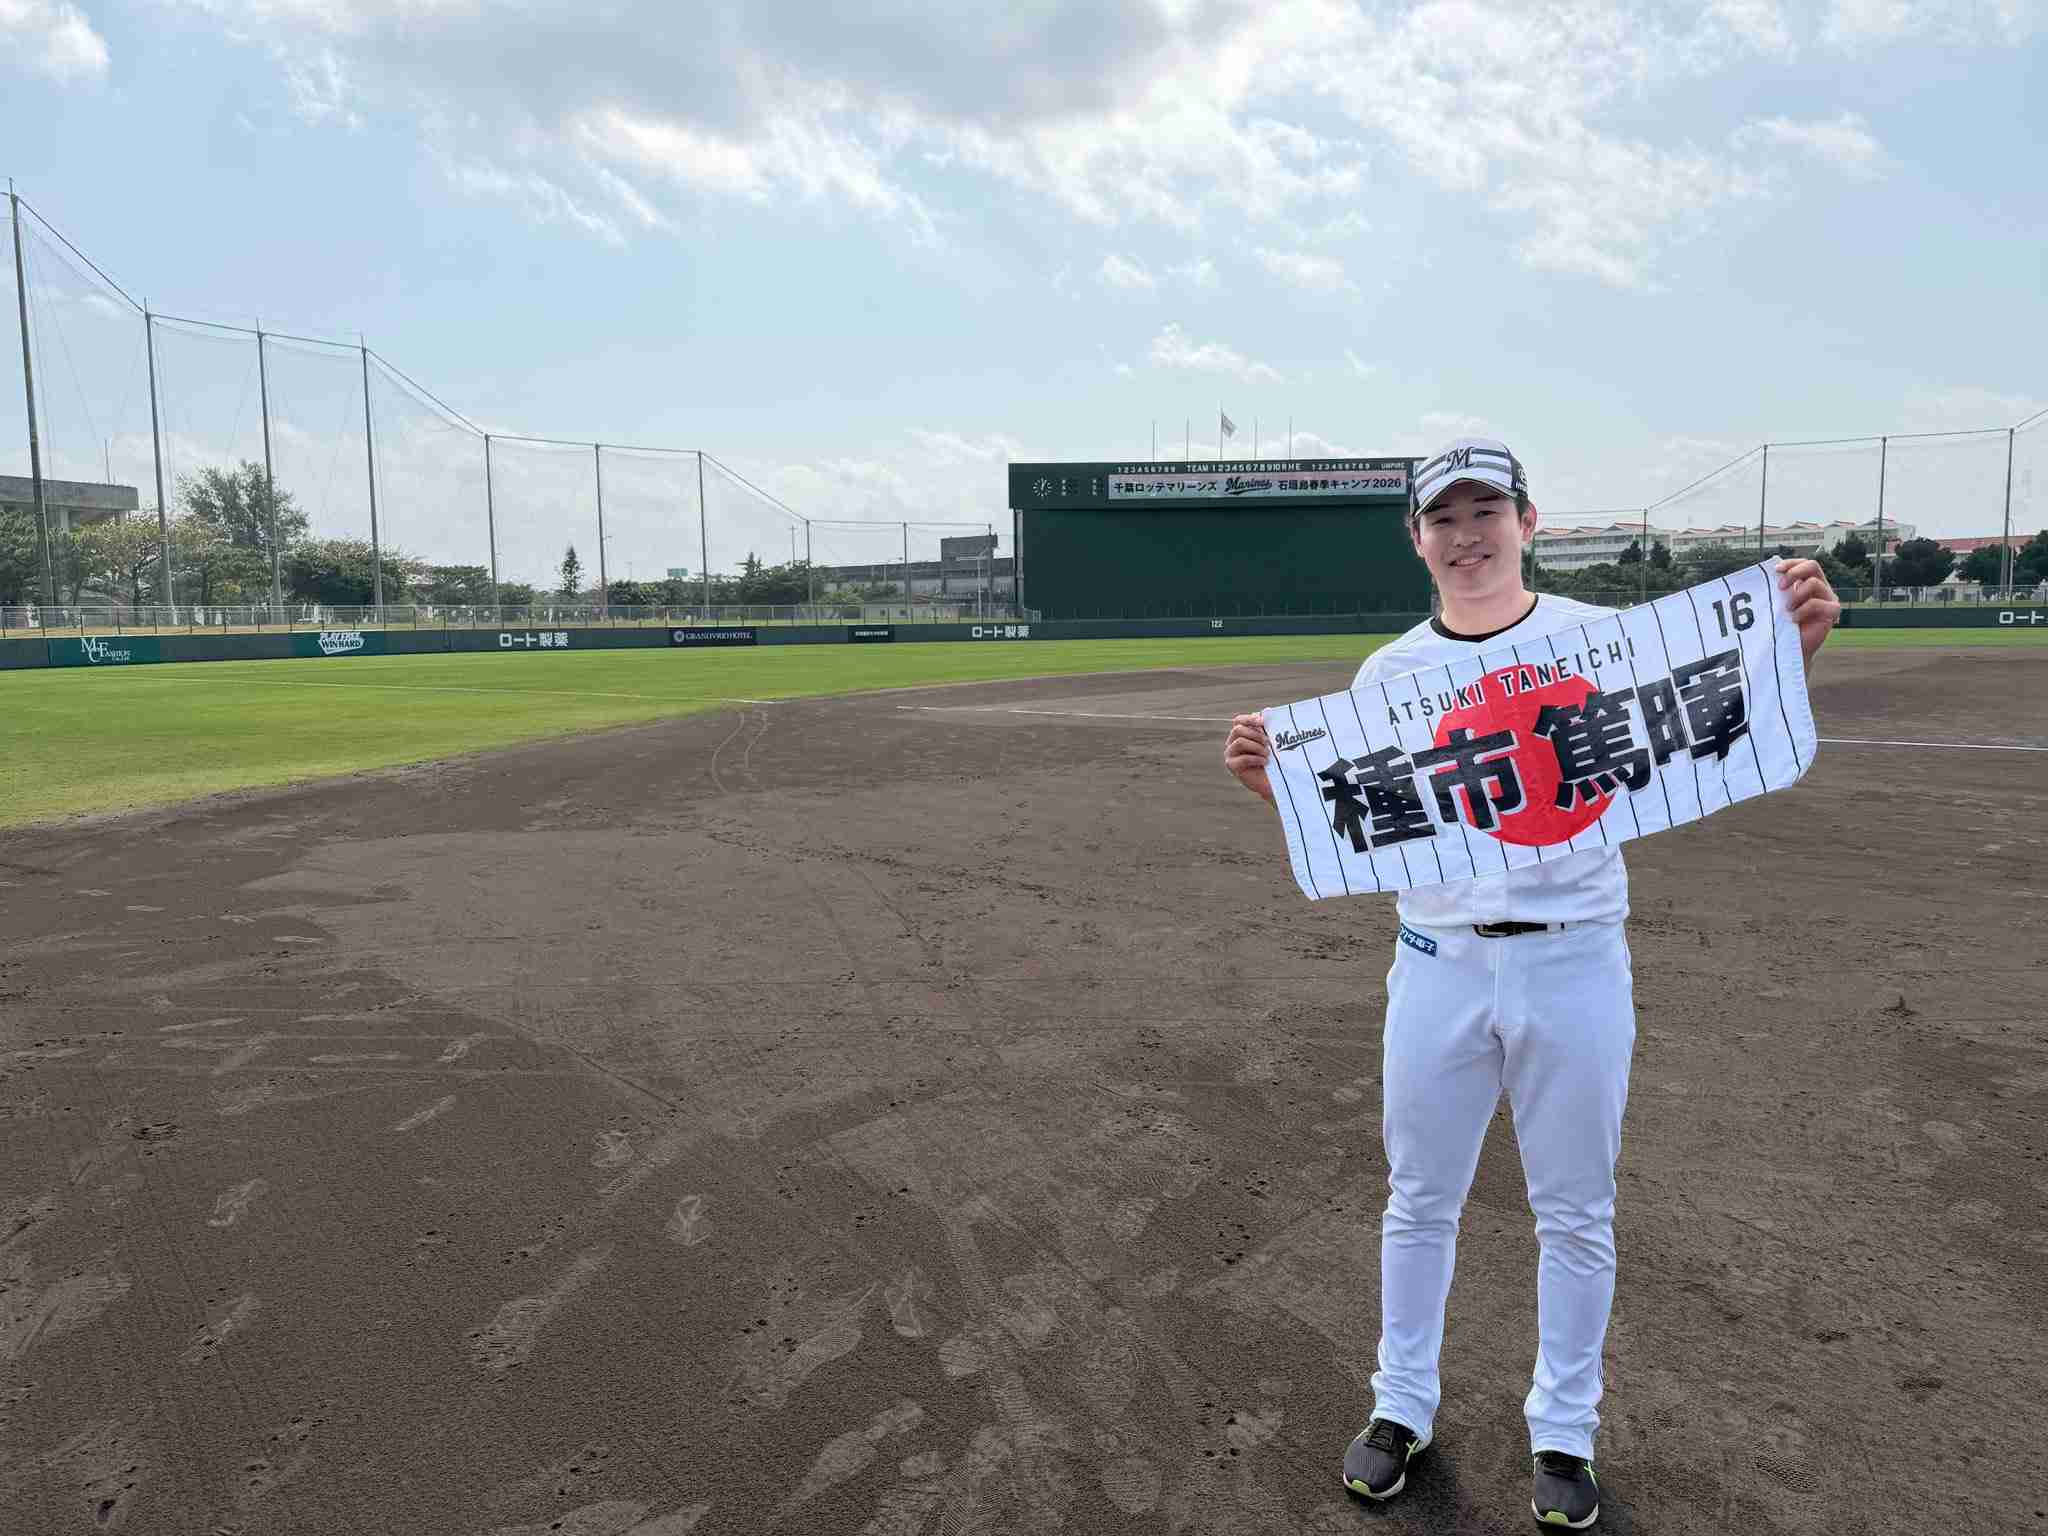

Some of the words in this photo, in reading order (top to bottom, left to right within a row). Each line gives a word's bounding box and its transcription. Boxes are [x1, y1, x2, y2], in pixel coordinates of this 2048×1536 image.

[1445, 446, 1474, 474] M
[1113, 481, 1217, 493] 千葉ロッテマリーンズ
[1224, 476, 1273, 495] Marines
[1712, 592, 1755, 638] 16
[499, 632, 569, 648] ロート製薬
[971, 625, 1030, 639] ロート製薬
[1387, 683, 1485, 725] ATSUKI
[1500, 637, 1636, 698] TANEICHI
[1275, 727, 1326, 751] Marines
